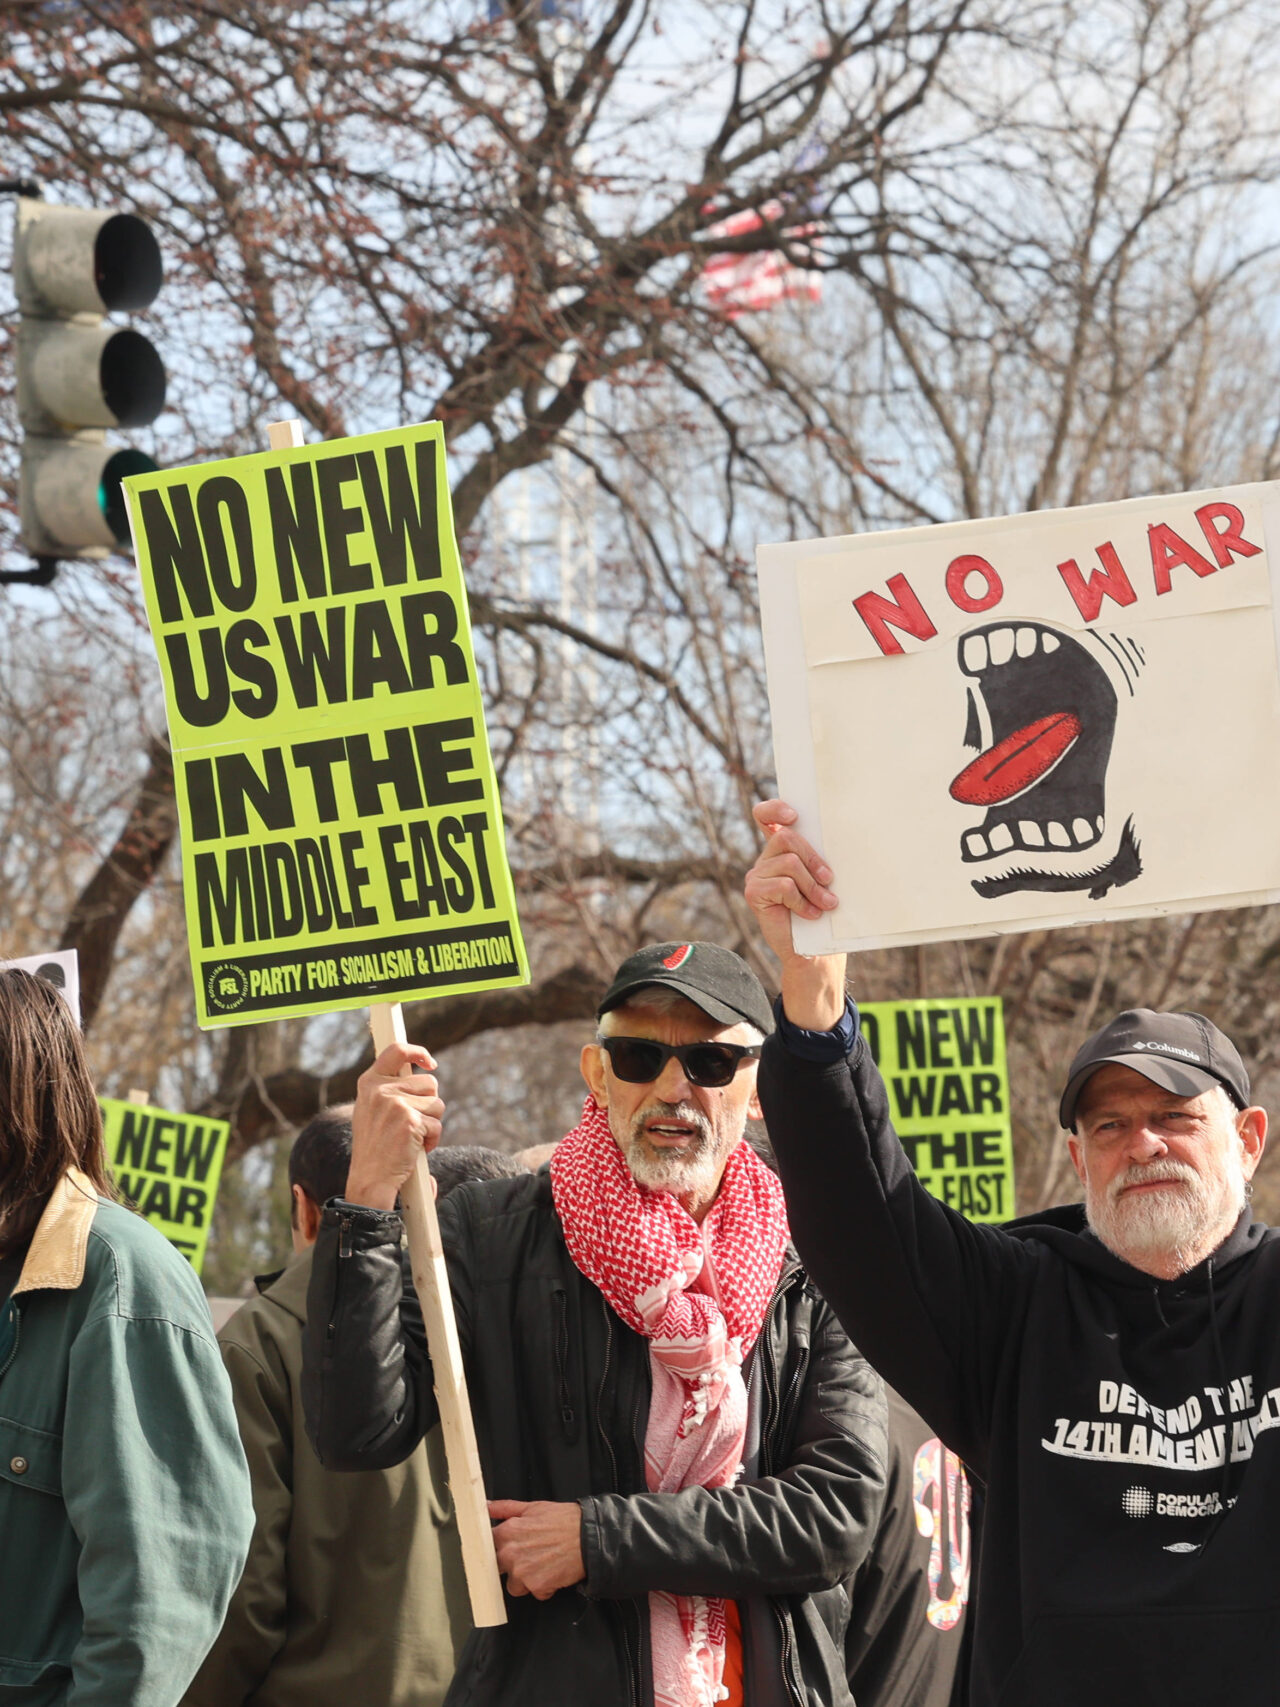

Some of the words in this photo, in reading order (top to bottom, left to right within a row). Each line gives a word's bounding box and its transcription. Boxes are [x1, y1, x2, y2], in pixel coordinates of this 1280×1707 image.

[138, 476, 257, 623] NO
[265, 440, 442, 603] NEW
[853, 555, 1003, 655] NO
[1057, 502, 1263, 623] WAR
[164, 619, 278, 727] US
[274, 590, 469, 709] WAR
[184, 746, 295, 842] IN
[292, 717, 484, 823] THE
[194, 830, 378, 948] MIDDLE
[378, 813, 496, 922] EAST
[219, 978, 240, 996] PSL
[249, 963, 303, 997] PARTY
[306, 959, 340, 990] FOR
[340, 949, 415, 986] SOCIALISM
[416, 949, 431, 975] &
[429, 936, 514, 972] LIBERATION
[896, 1006, 995, 1070] NEW
[1147, 1041, 1200, 1061] Columbia
[892, 1072, 1003, 1118] WAR
[115, 1111, 221, 1183] NEW
[900, 1130, 1005, 1170] THE
[1052, 1418, 1122, 1451] 14TH
[1100, 1380, 1201, 1434] DEFEND
[1204, 1375, 1255, 1416] THE
[1157, 1492, 1220, 1507] POPULAR
